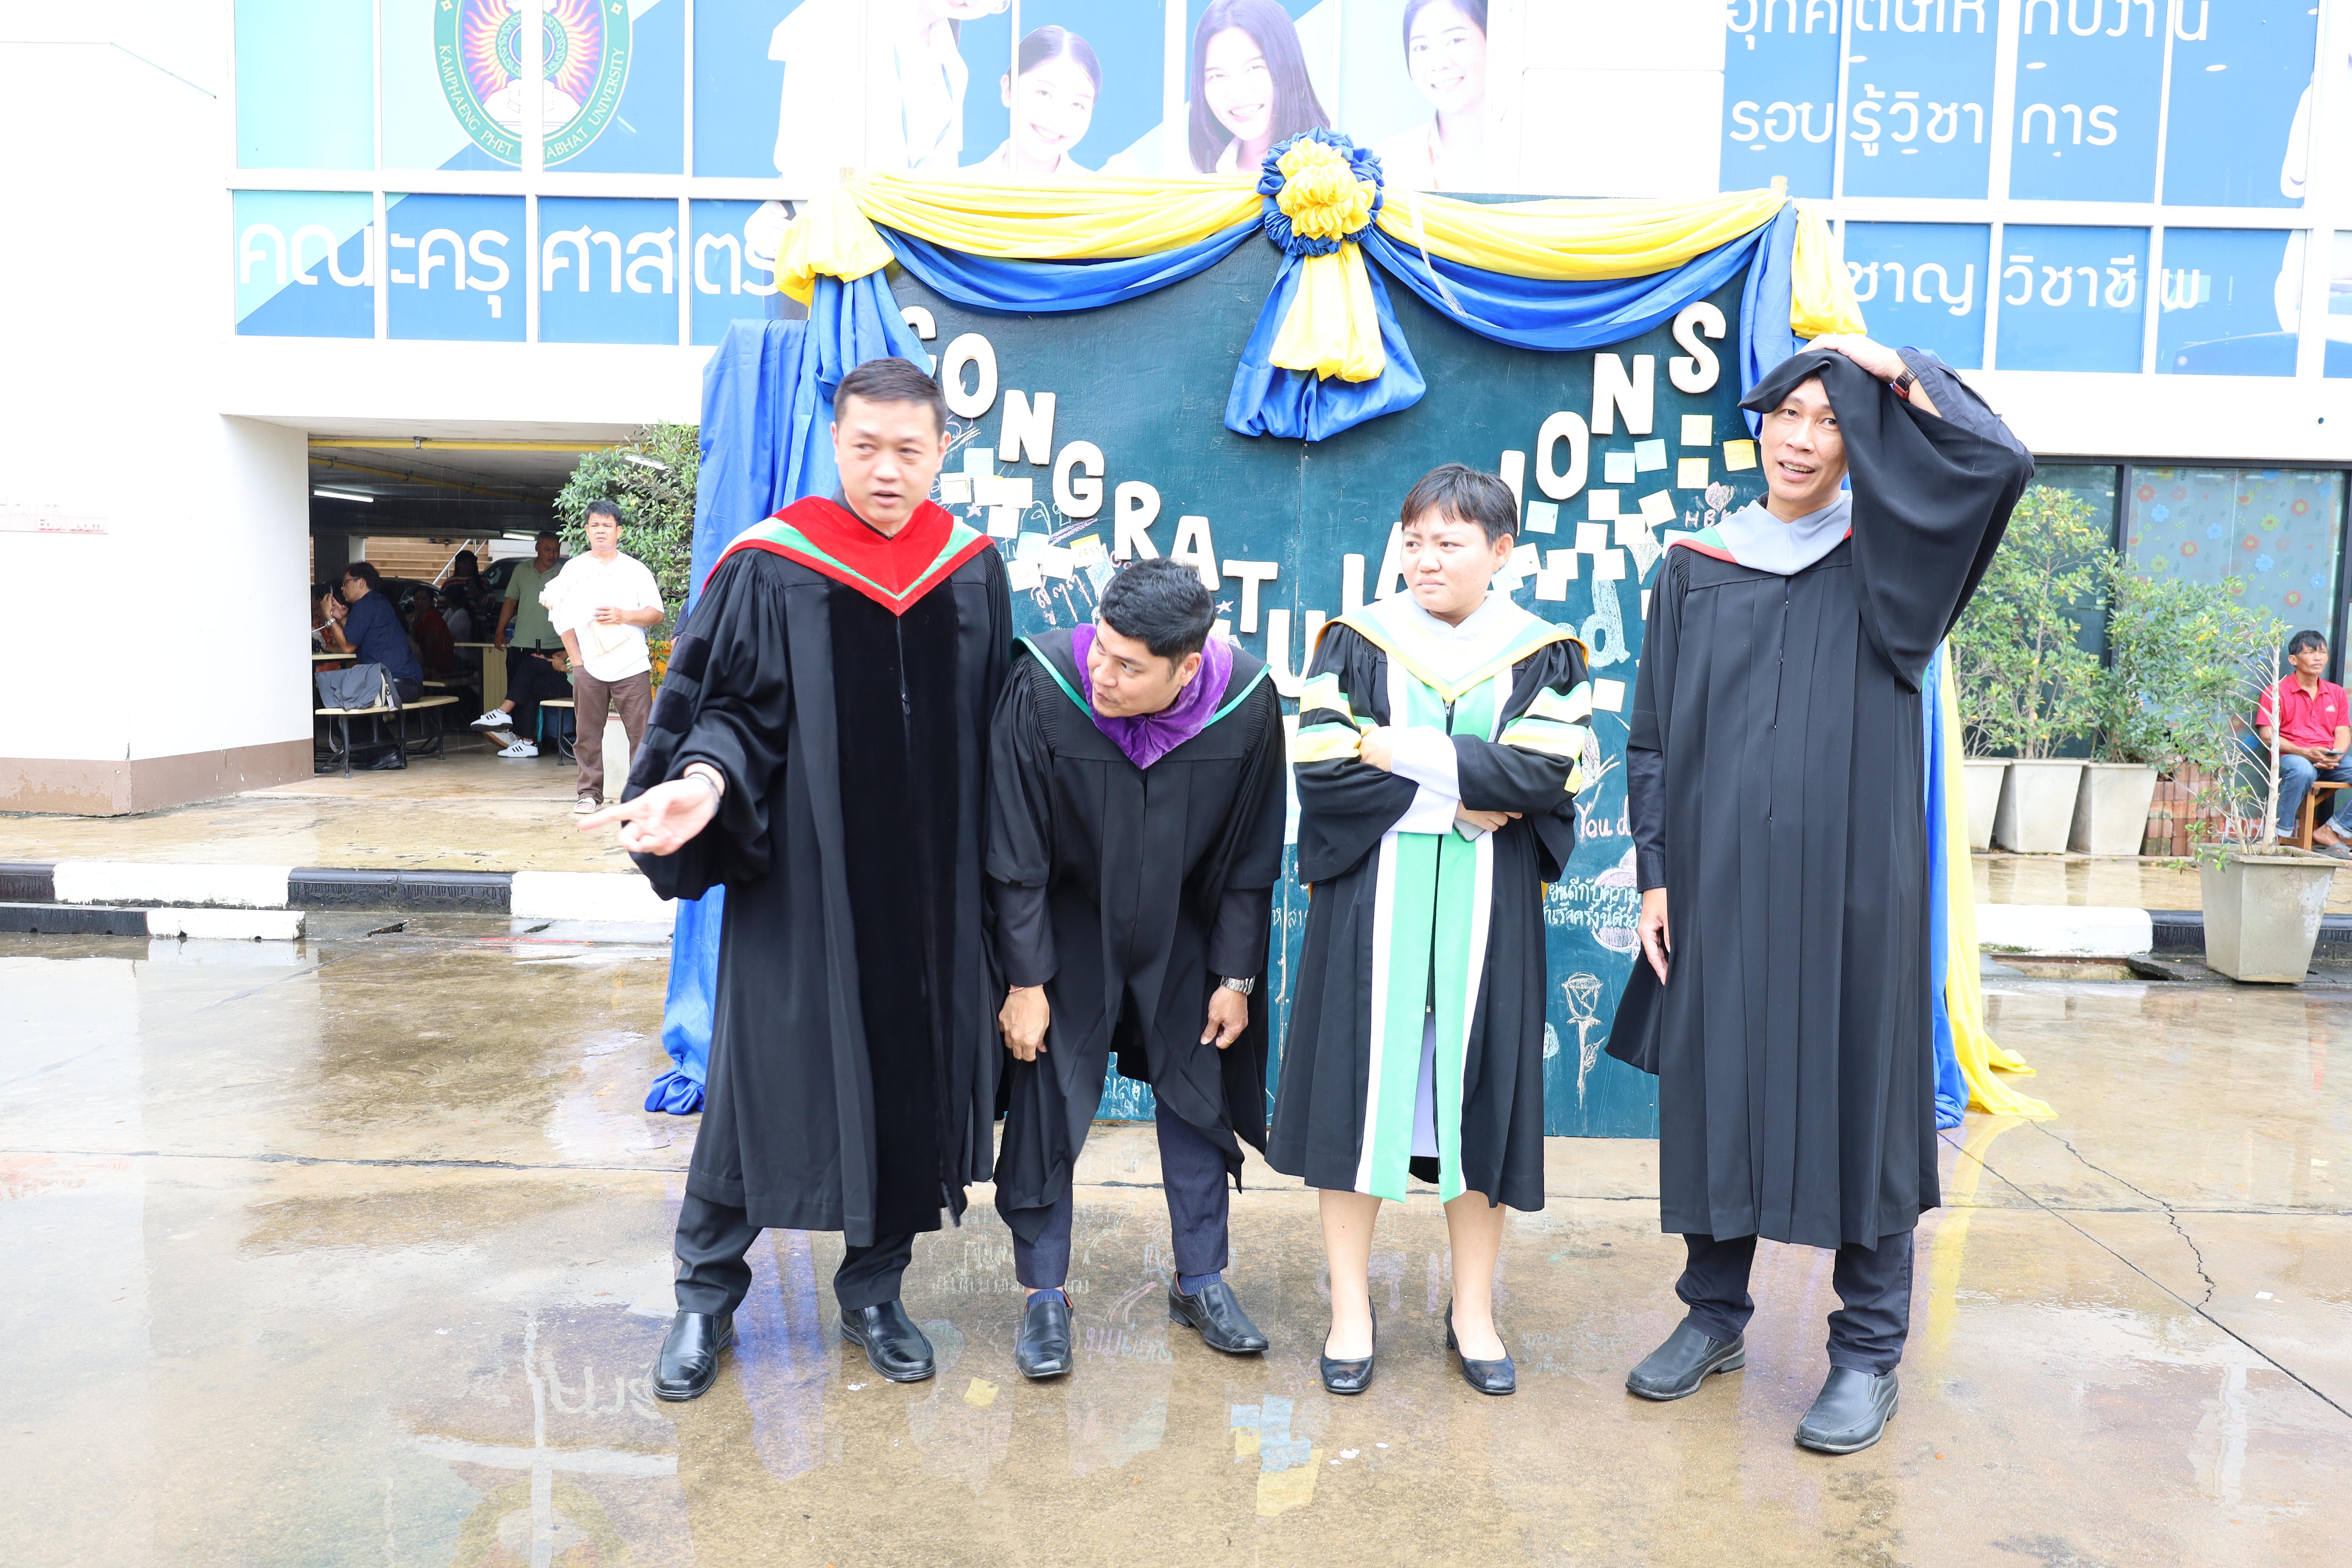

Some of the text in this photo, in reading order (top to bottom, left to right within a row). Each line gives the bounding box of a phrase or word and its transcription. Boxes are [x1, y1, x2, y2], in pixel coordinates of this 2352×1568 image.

[439, 44, 625, 159] KAMPHAENG PHET ABHAT UNIVERSITY
[240, 222, 779, 318] คณะครุศาสตร
[1846, 254, 2200, 316] ชาญวิชาชีพ
[1575, 801, 1614, 840] You
